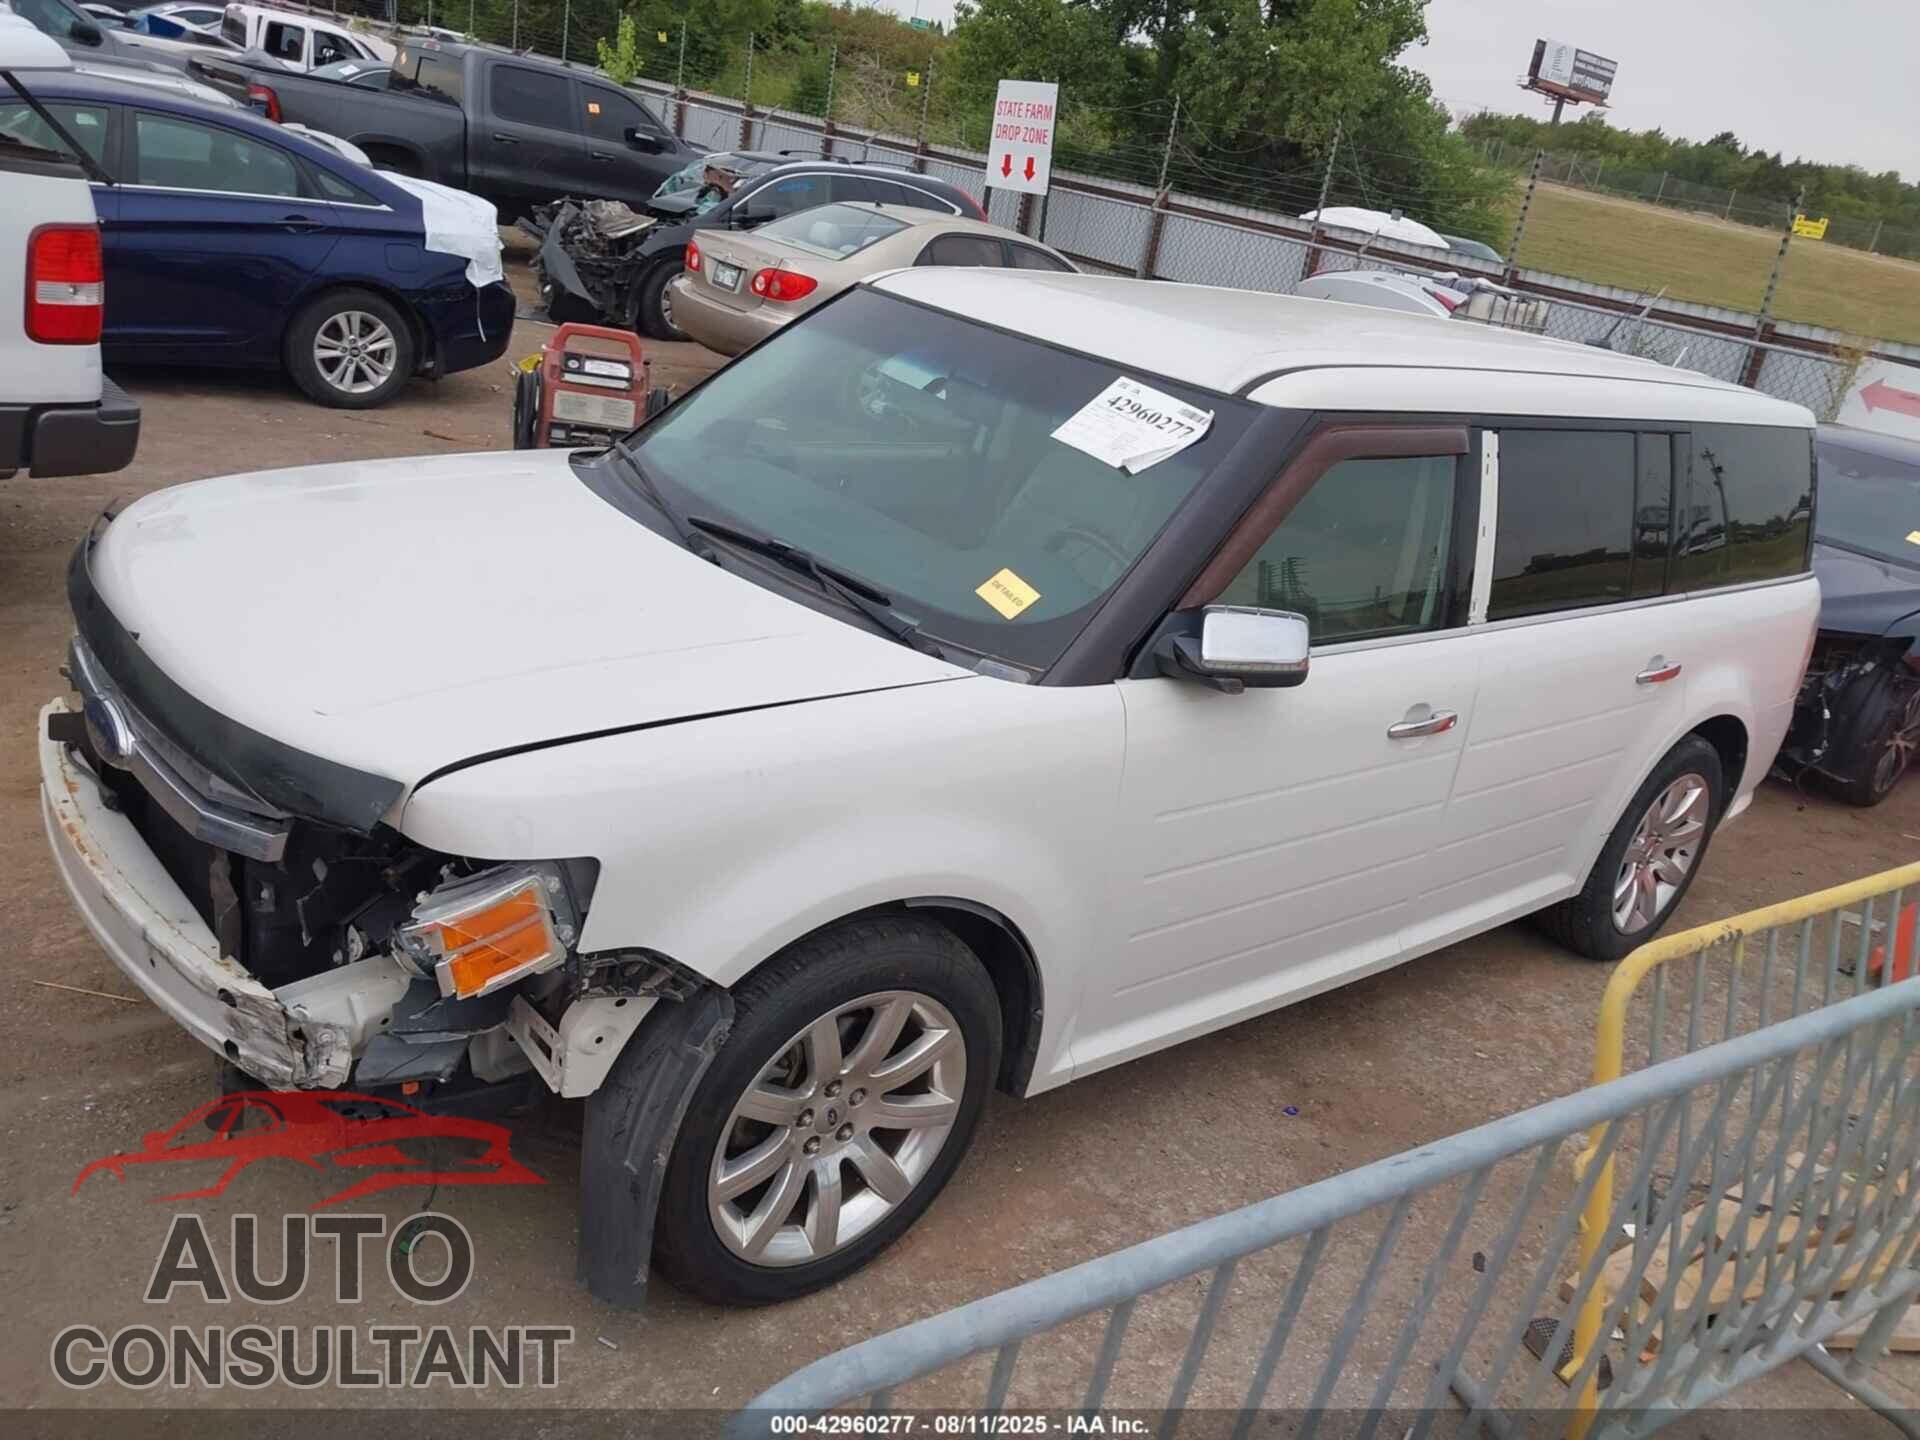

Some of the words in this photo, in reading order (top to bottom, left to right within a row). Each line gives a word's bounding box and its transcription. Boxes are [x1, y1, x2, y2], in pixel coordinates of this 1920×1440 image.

[997, 101, 1023, 118] STATE
[1024, 103, 1053, 121] FARM
[995, 124, 1021, 141] DROP
[1022, 127, 1049, 145] ZONE
[1107, 395, 1195, 440] 42960277
